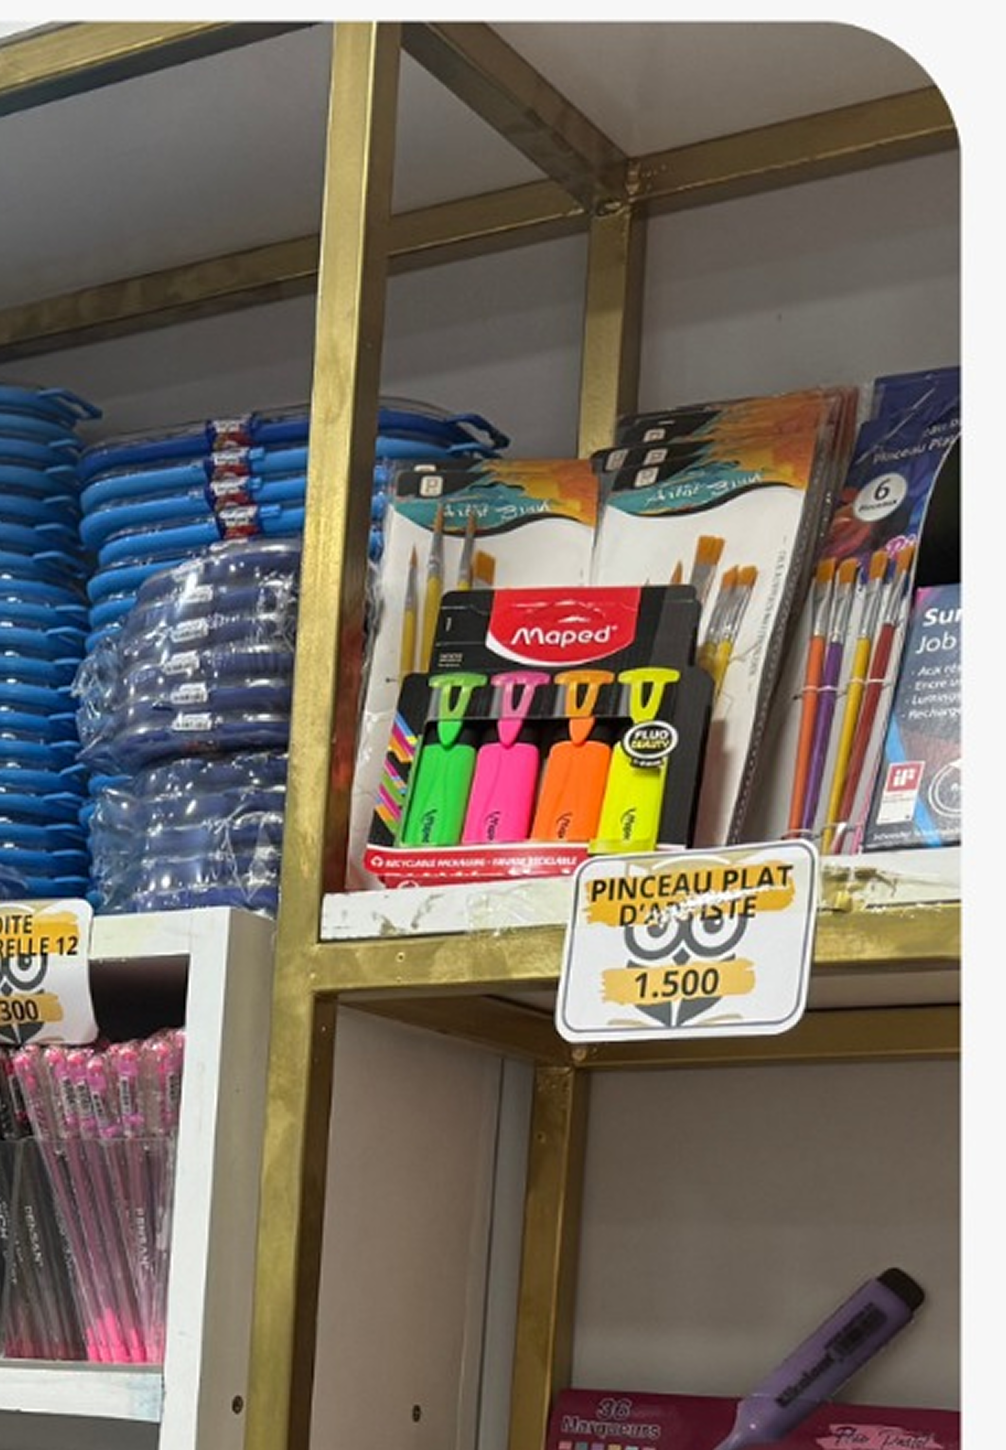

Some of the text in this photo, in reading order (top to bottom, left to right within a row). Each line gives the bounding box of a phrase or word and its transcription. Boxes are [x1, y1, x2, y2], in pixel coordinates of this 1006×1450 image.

[874, 478, 891, 502] 6
[510, 626, 611, 648] Maped
[915, 631, 957, 655] Job
[633, 729, 669, 742] FLUO
[591, 864, 794, 902] PINCEAU PLAT
[55, 935, 79, 957] 12
[633, 967, 720, 999] 1.500
[595, 1397, 632, 1421] 36
[561, 1415, 662, 1440] Marqueurs
